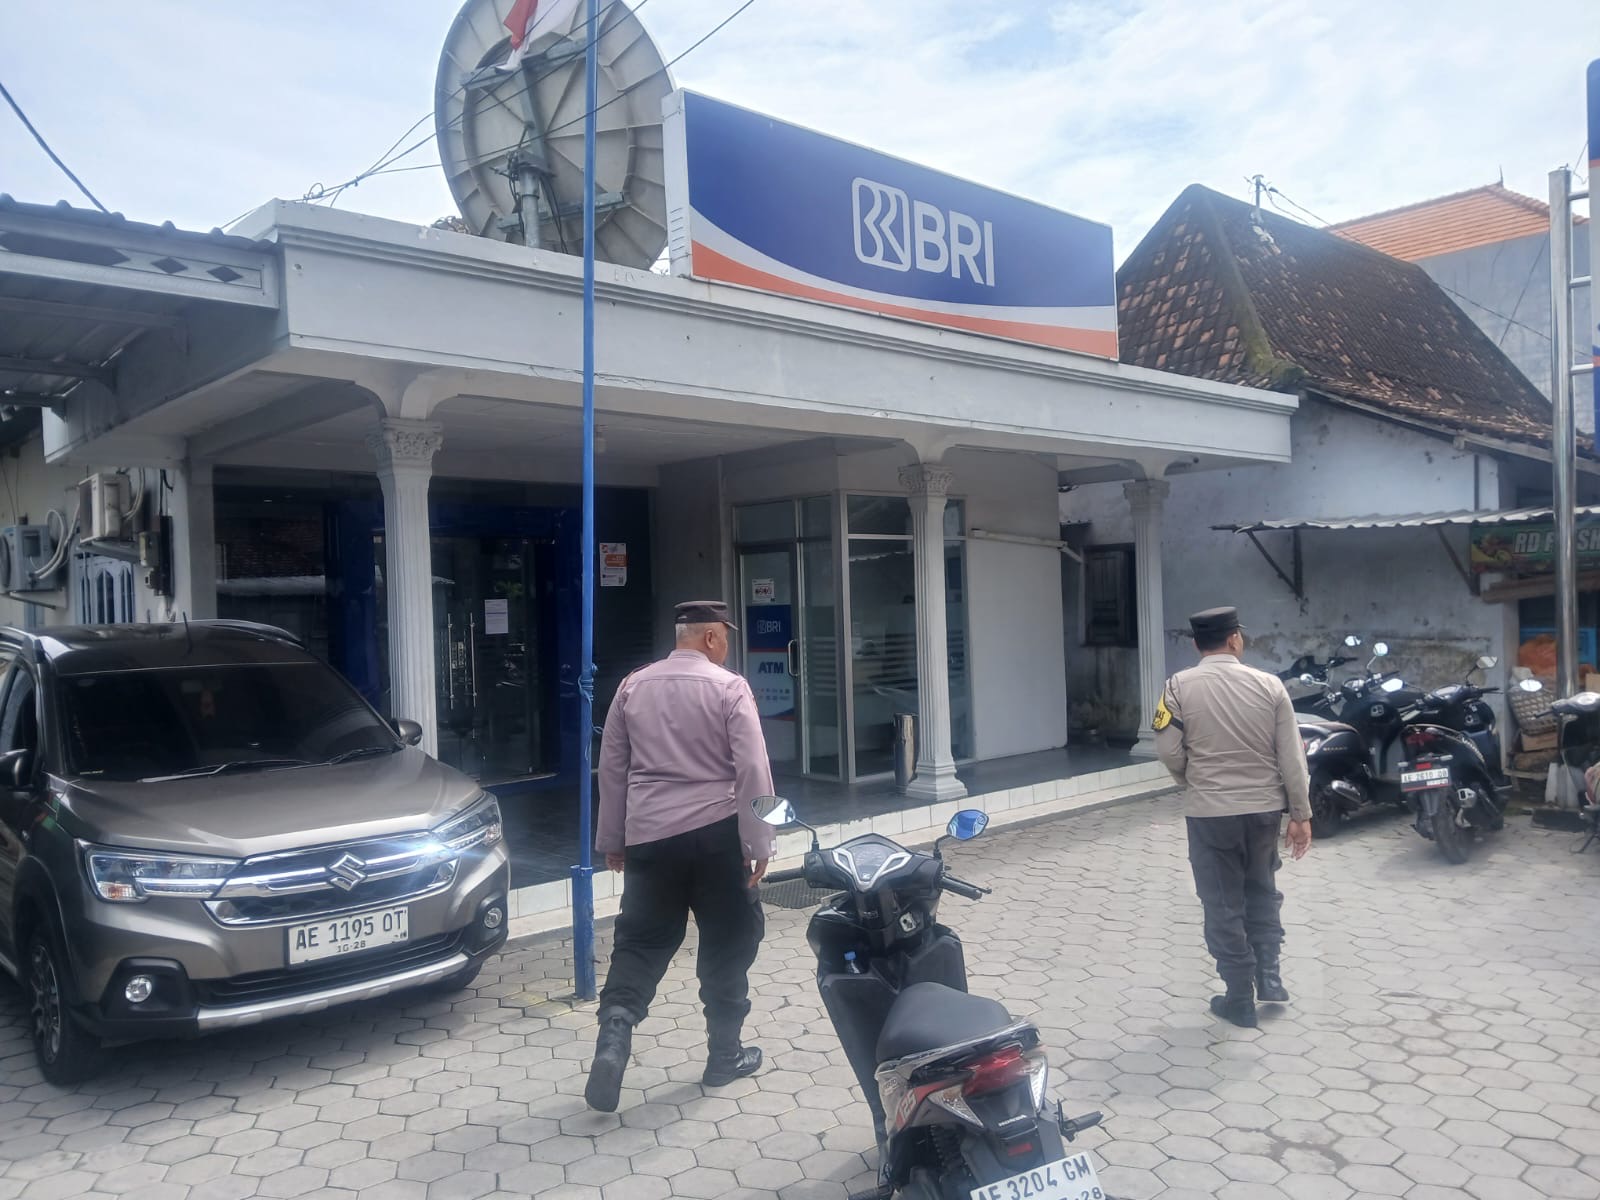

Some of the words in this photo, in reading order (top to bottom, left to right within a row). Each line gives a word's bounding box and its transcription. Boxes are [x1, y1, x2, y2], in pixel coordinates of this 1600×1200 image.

[913, 199, 995, 288] BRI
[1513, 531, 1541, 554] RD
[766, 620, 782, 633] BRI
[758, 661, 784, 674] ATM
[295, 926, 320, 951] AE
[328, 916, 375, 944] 1195
[382, 910, 405, 932] OT
[1007, 1167, 1058, 1200] 3204
[1062, 1154, 1091, 1181] GM
